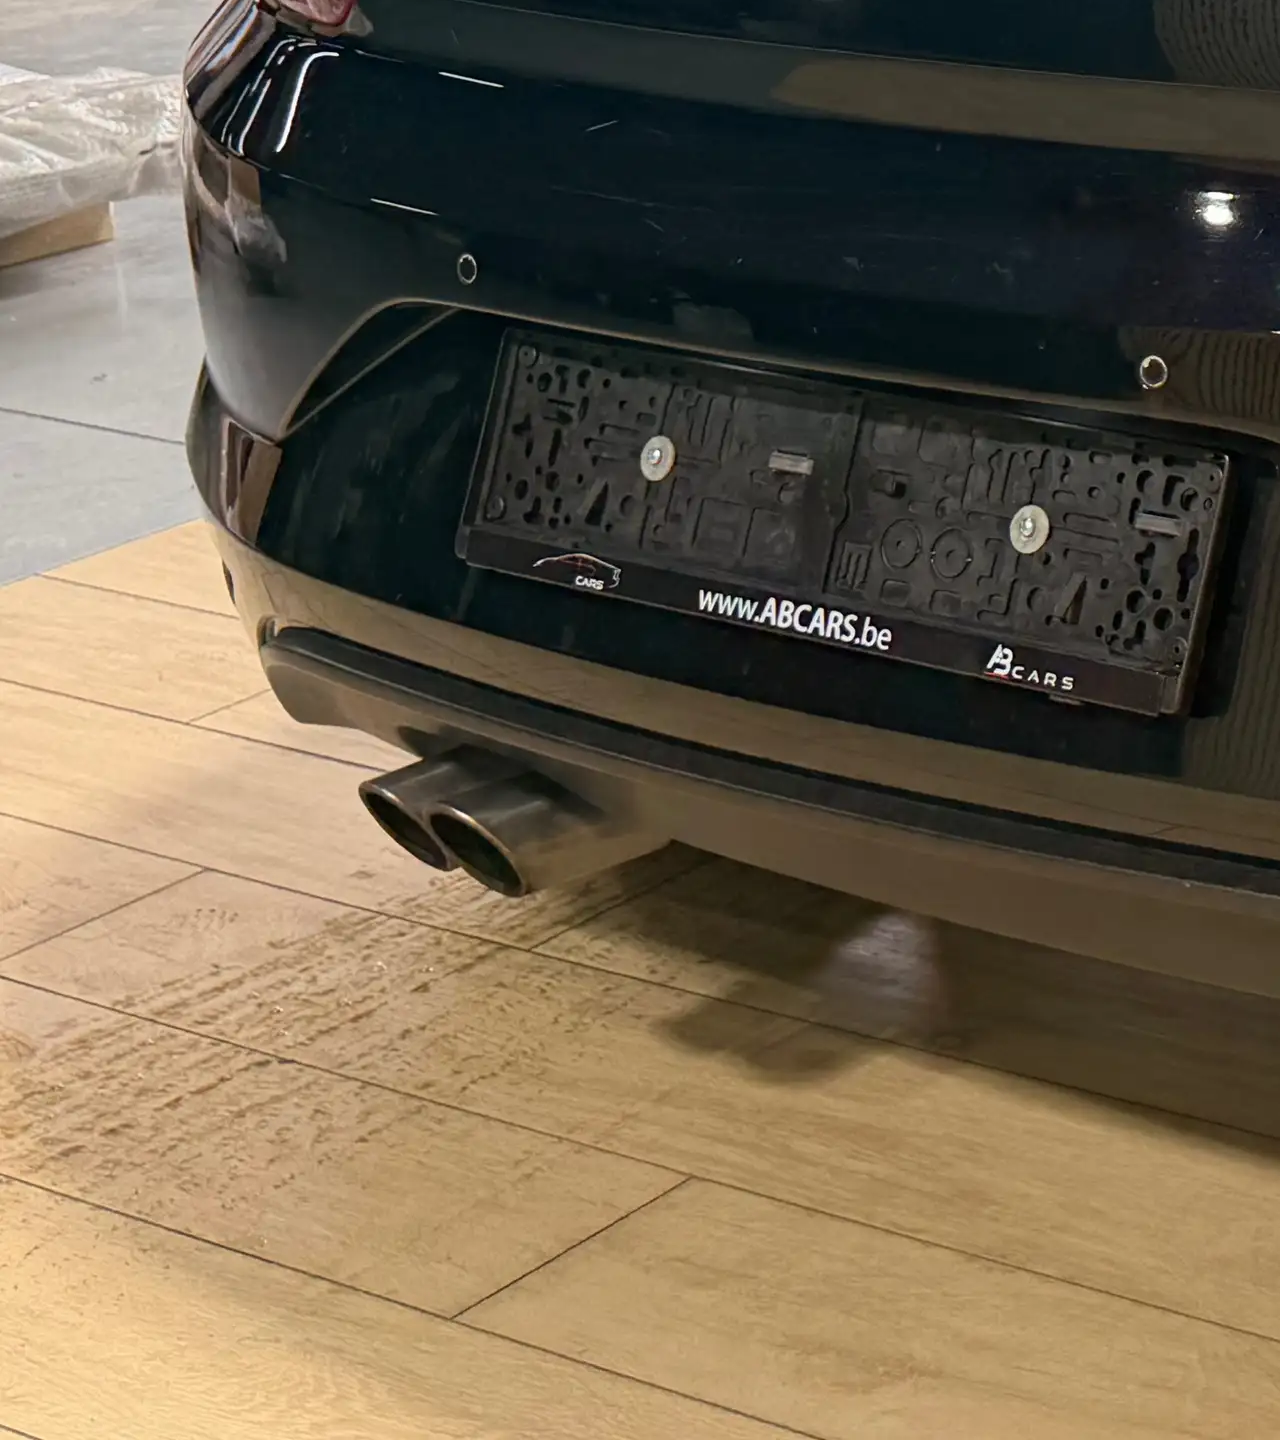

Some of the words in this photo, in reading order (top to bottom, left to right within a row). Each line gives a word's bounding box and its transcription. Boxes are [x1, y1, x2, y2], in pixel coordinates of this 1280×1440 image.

[575, 575, 604, 591] CARS
[698, 589, 893, 651] www.ABCARS.be
[1011, 665, 1074, 690] CARS
